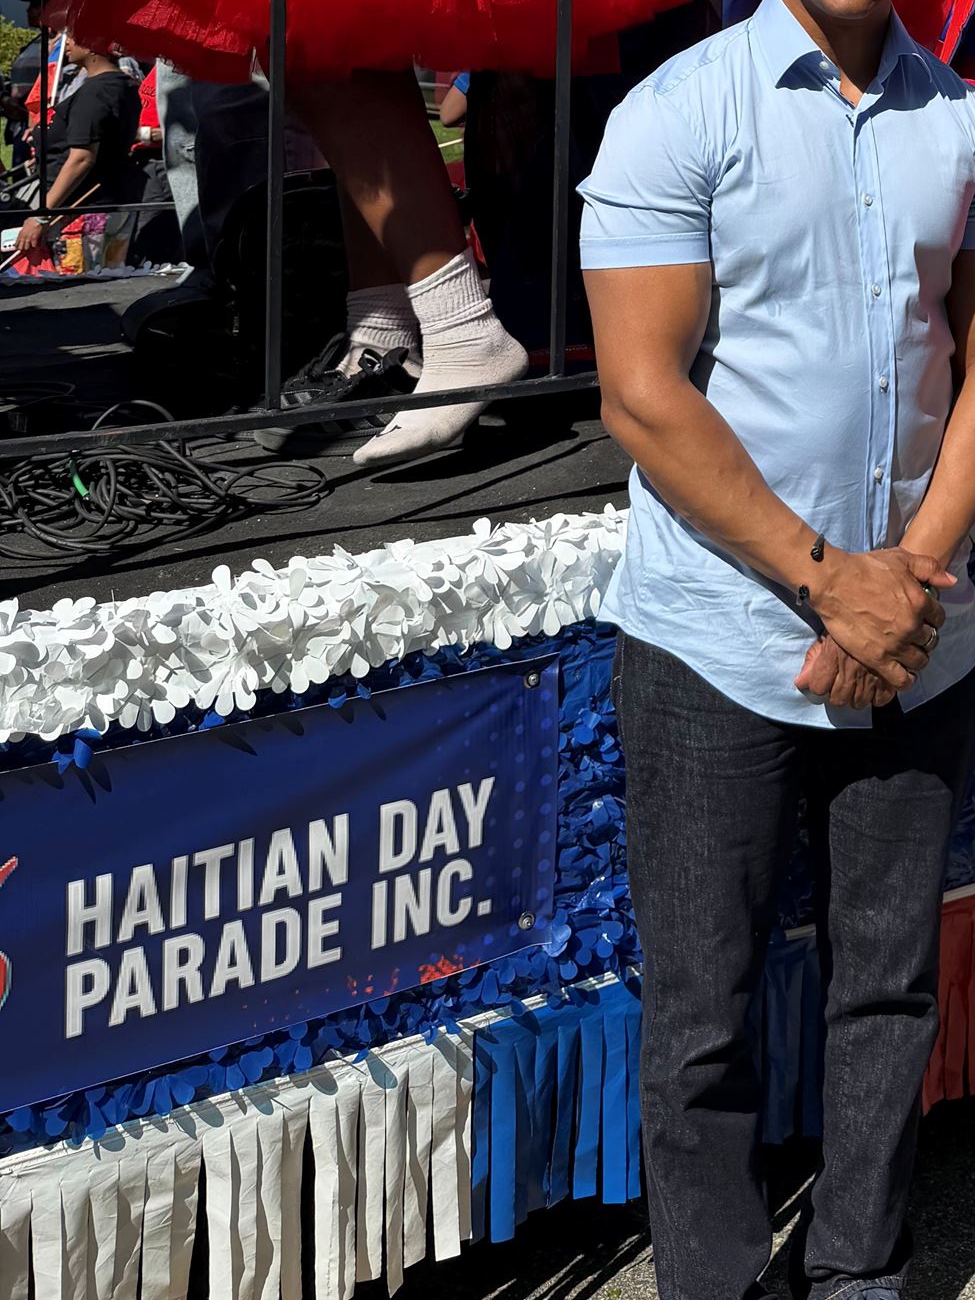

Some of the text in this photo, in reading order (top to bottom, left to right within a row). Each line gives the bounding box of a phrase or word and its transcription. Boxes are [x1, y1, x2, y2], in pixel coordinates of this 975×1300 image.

[64, 857, 493, 1040] PARADE INC.
[65, 776, 497, 957] HAITIAN DAY
